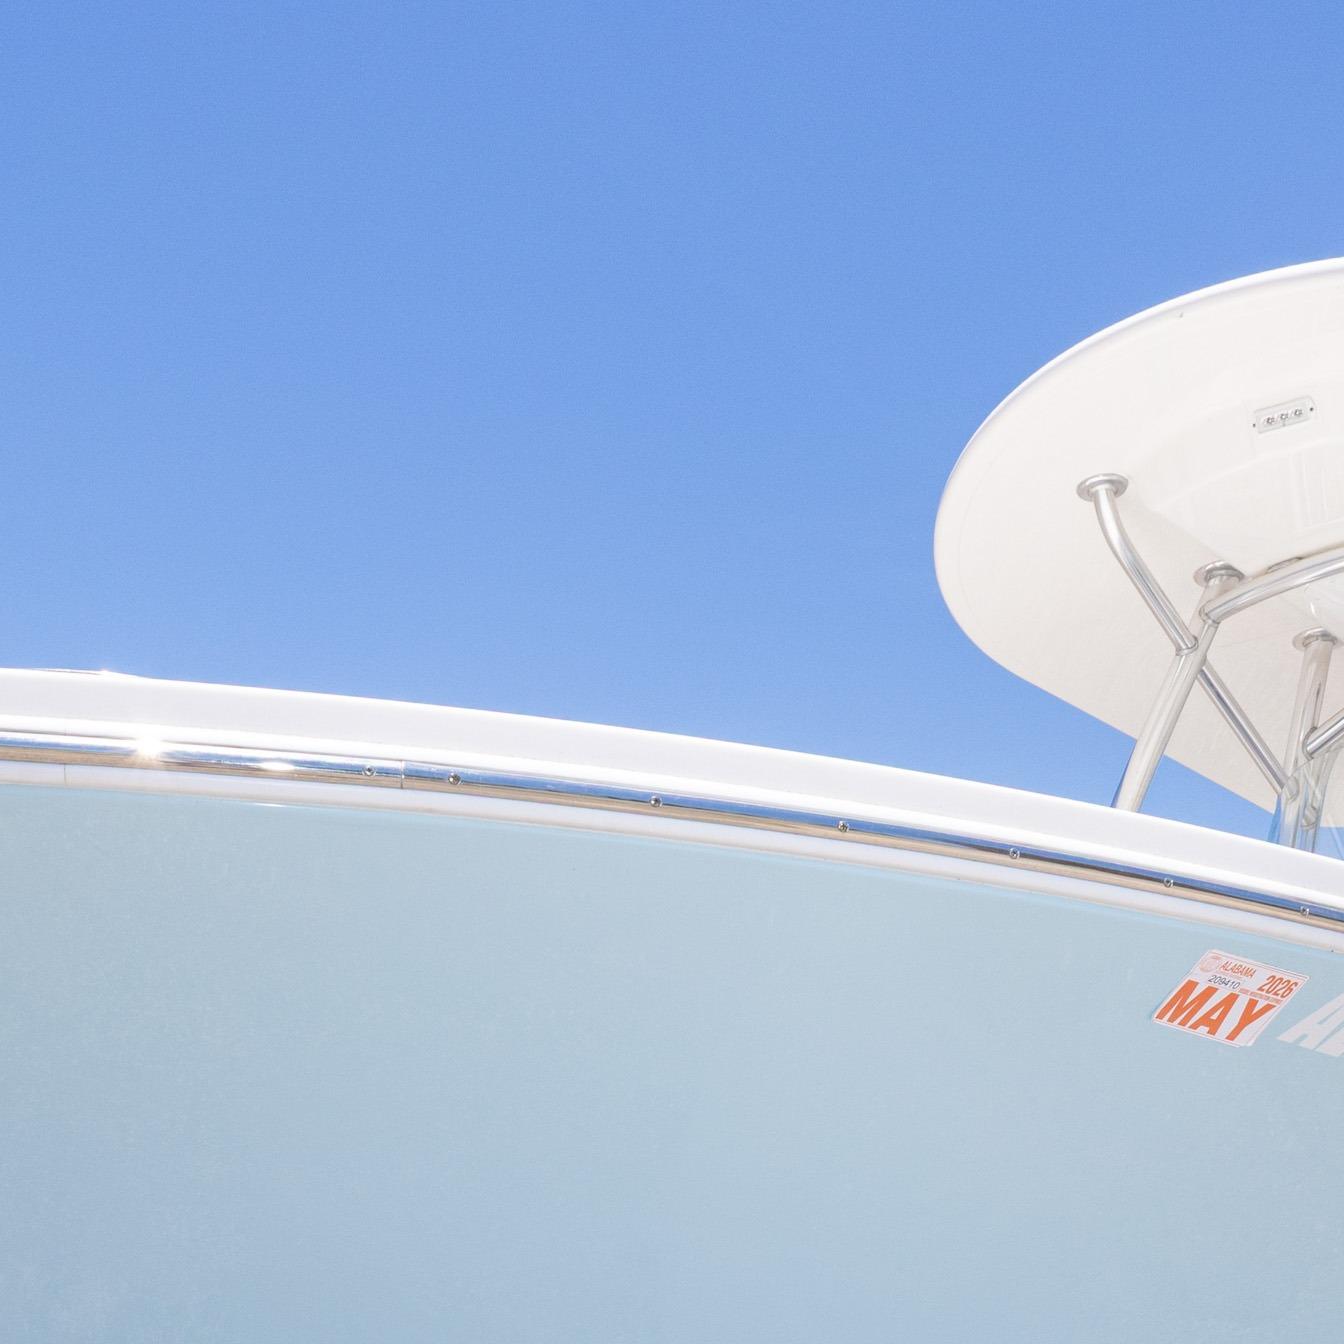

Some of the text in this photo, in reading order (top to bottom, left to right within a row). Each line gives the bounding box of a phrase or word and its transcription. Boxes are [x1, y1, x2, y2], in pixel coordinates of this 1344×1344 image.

[1219, 961, 1257, 979] ALABAMA
[1207, 974, 1241, 990] 209410
[1257, 974, 1299, 999] 2026
[1155, 979, 1277, 1041] MAY
